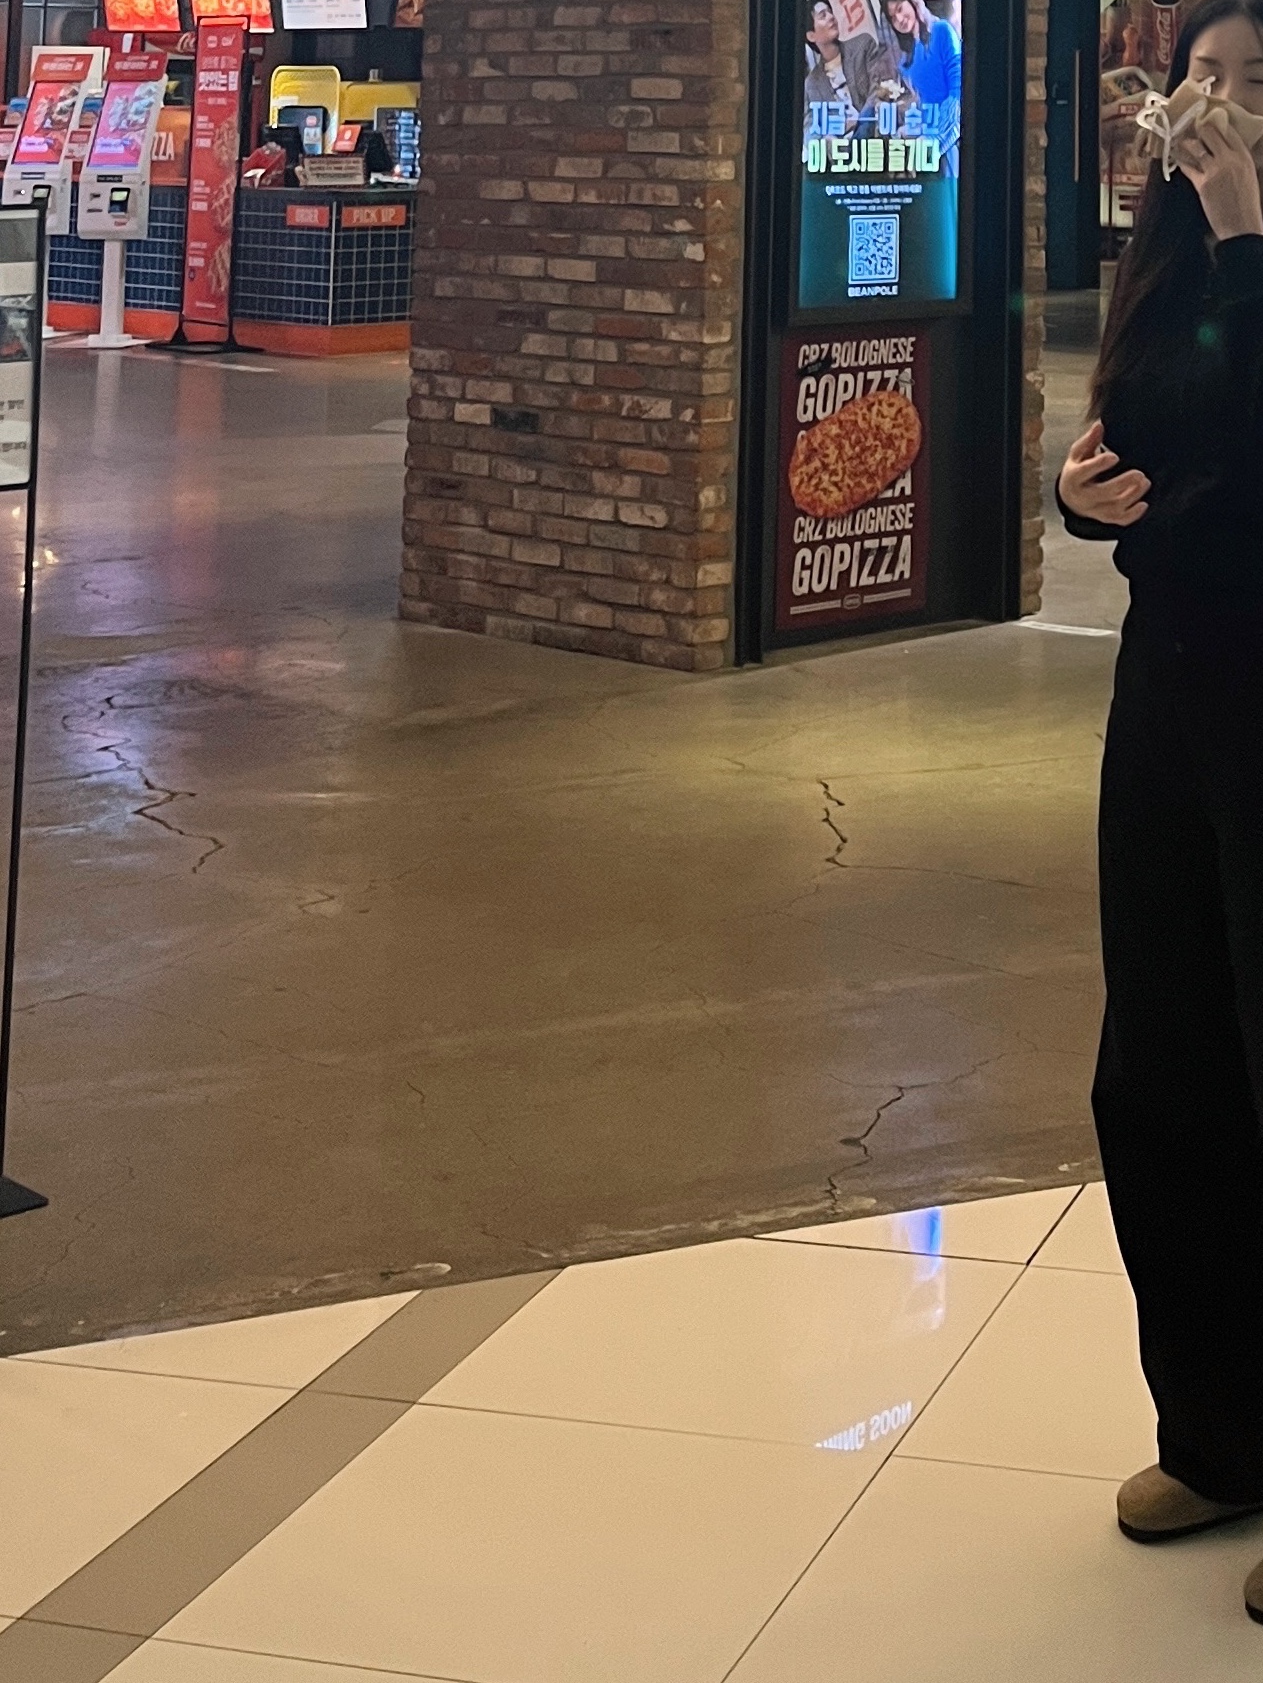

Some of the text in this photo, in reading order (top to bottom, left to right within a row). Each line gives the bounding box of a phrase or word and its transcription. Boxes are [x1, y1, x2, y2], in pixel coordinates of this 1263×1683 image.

[809, 101, 846, 135] 지금
[904, 101, 940, 136] 순간
[807, 138, 941, 174] 이 도시를 즐기다
[847, 284, 899, 298] BEANPOLE
[830, 336, 917, 369] BOLOGNESE
[793, 502, 915, 544] CRZ BOLOGNESE
[791, 534, 912, 597] GOPIZZA
